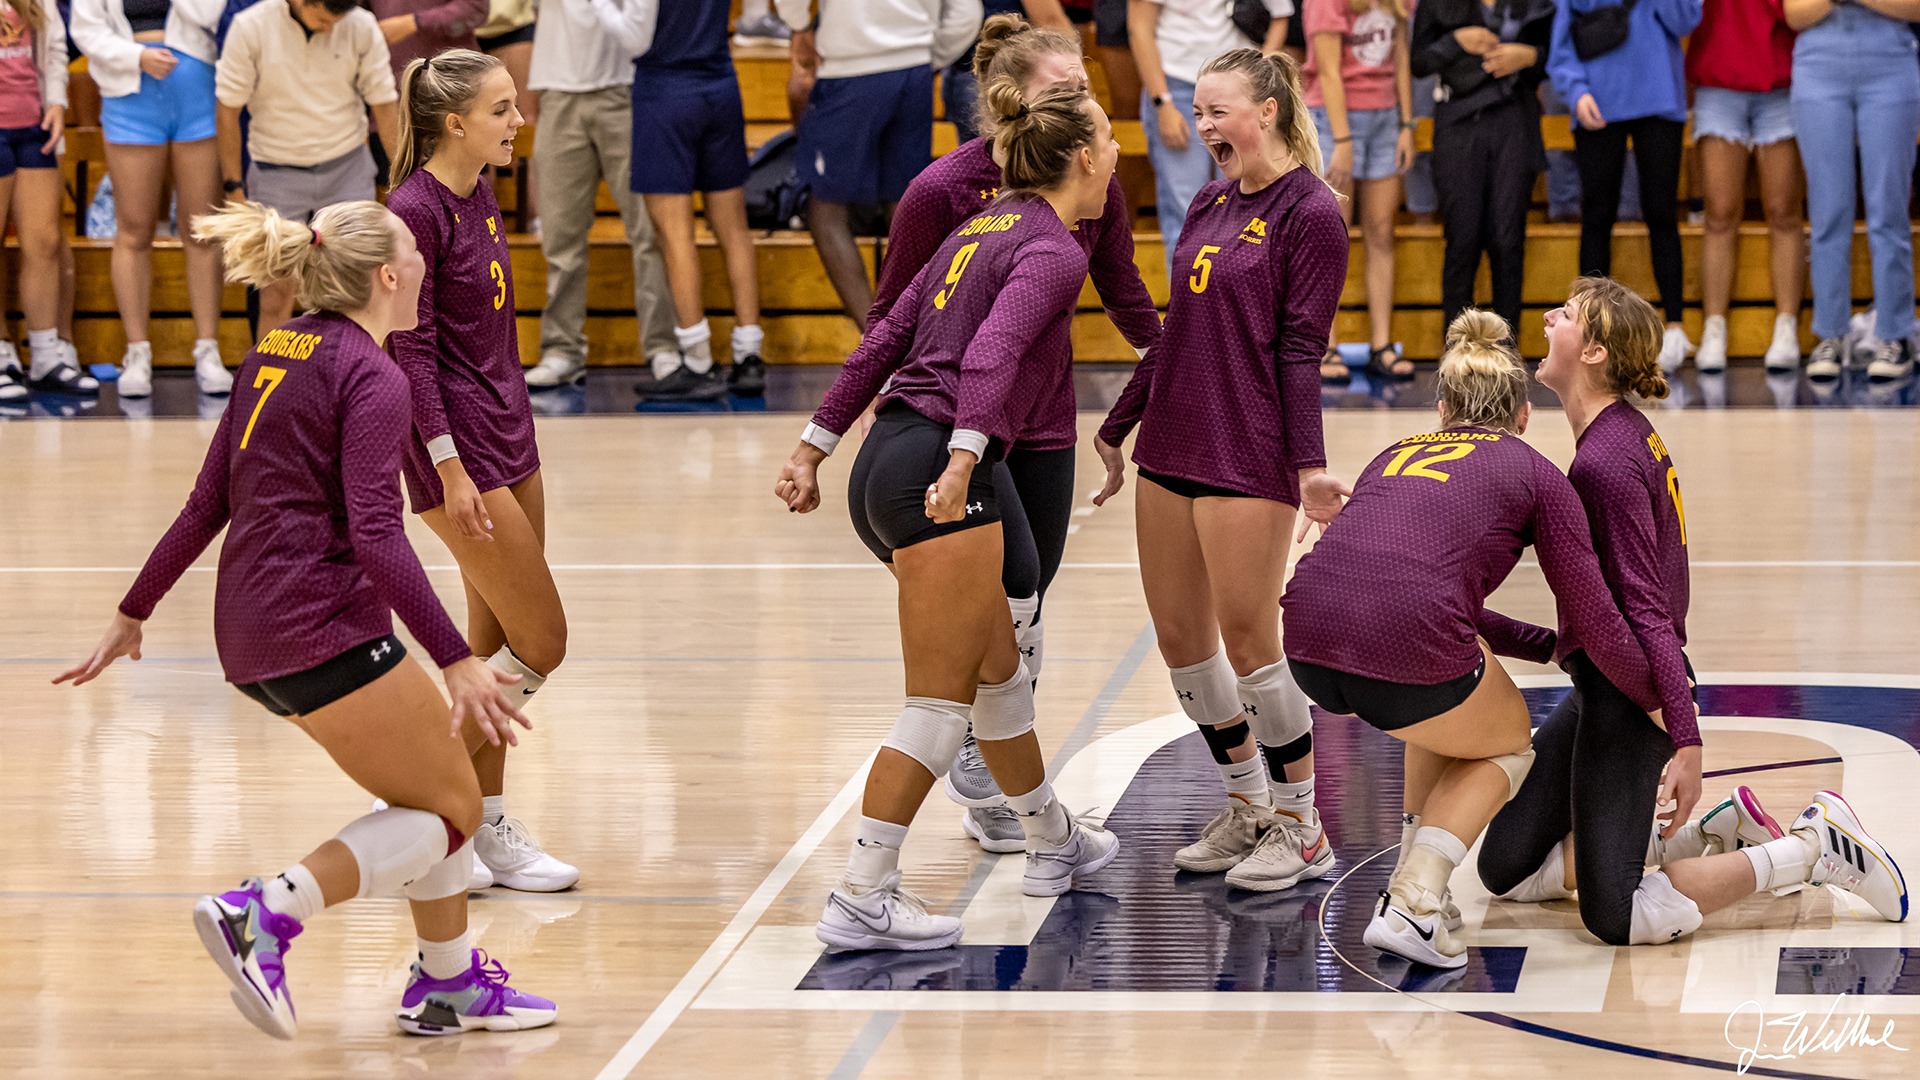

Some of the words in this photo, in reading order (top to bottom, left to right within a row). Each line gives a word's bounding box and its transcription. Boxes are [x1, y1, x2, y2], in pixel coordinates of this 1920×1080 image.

[489, 260, 506, 311] 3
[933, 241, 980, 310] 9
[1189, 244, 1221, 294] 5
[256, 328, 323, 361] COUGARS
[239, 365, 288, 450] 7
[1381, 442, 1477, 483] 12
